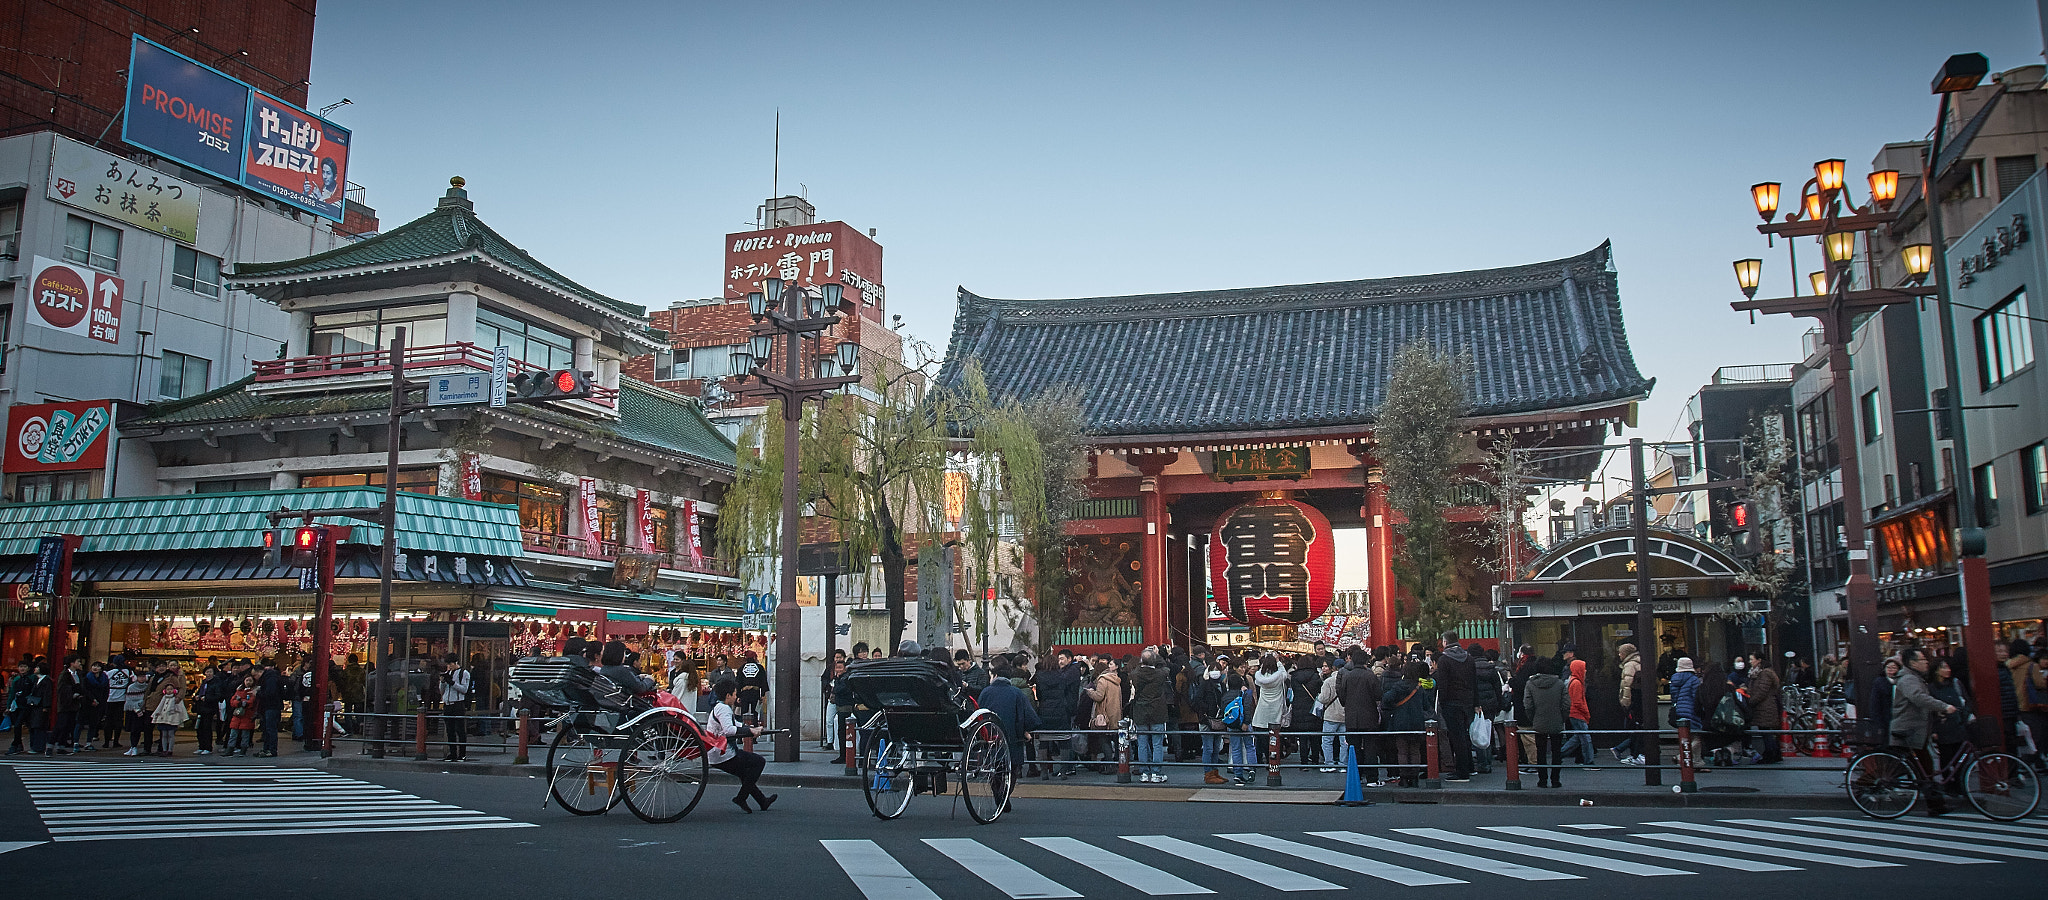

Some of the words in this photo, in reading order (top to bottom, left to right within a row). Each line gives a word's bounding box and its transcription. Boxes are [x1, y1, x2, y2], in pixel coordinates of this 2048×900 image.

[142, 83, 233, 139] PROMISE
[260, 106, 321, 152] やっぱり
[198, 131, 230, 153] プロミス
[58, 179, 76, 194] 2F
[106, 160, 183, 200] あんみつ
[94, 184, 162, 223] お抹茶
[40, 289, 83, 313] ガスト
[93, 308, 119, 327] 160m
[92, 324, 117, 342] 右側
[438, 376, 480, 392] 雷門
[439, 392, 479, 401] Kaminarimon
[1219, 504, 1317, 624] 雷門
